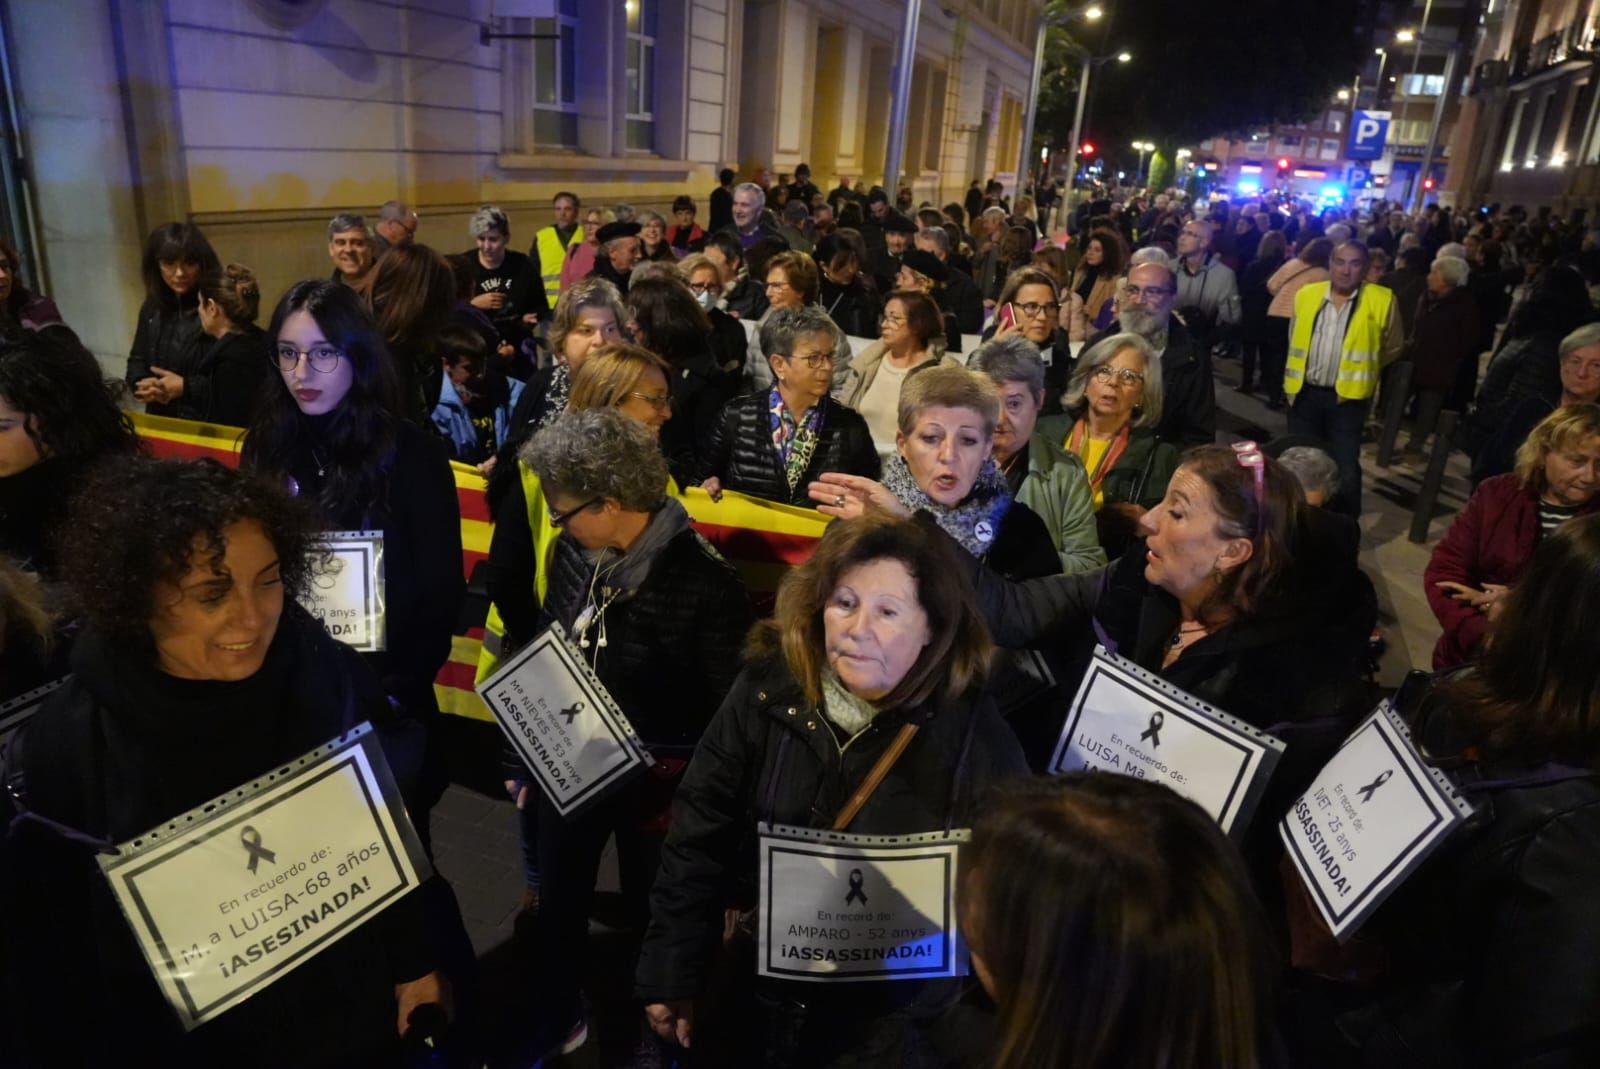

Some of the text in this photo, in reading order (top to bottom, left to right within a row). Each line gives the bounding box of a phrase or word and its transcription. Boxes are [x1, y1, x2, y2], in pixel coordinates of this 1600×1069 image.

[1356, 120, 1380, 144] P
[1350, 170, 1365, 187] P
[330, 608, 356, 618] anys
[537, 698, 548, 708] En
[546, 708, 566, 736] record
[520, 696, 551, 736] NIEVES
[553, 744, 566, 758] 53
[563, 758, 583, 785] anys
[1078, 733, 1120, 768] LUISA
[1110, 733, 1188, 785] En recuerdo de:
[1333, 783, 1344, 797] En
[1340, 796, 1358, 820] record
[1314, 787, 1332, 811] IVET
[1328, 816, 1344, 835] 25
[1336, 832, 1358, 862] anys
[219, 846, 333, 915] En recuerdo de:
[228, 871, 331, 940] LUISA-68
[337, 841, 381, 876] años
[788, 924, 850, 940] AMPARO
[868, 929, 886, 940] 52
[891, 927, 926, 942] anys
[817, 910, 896, 922] En record de:
